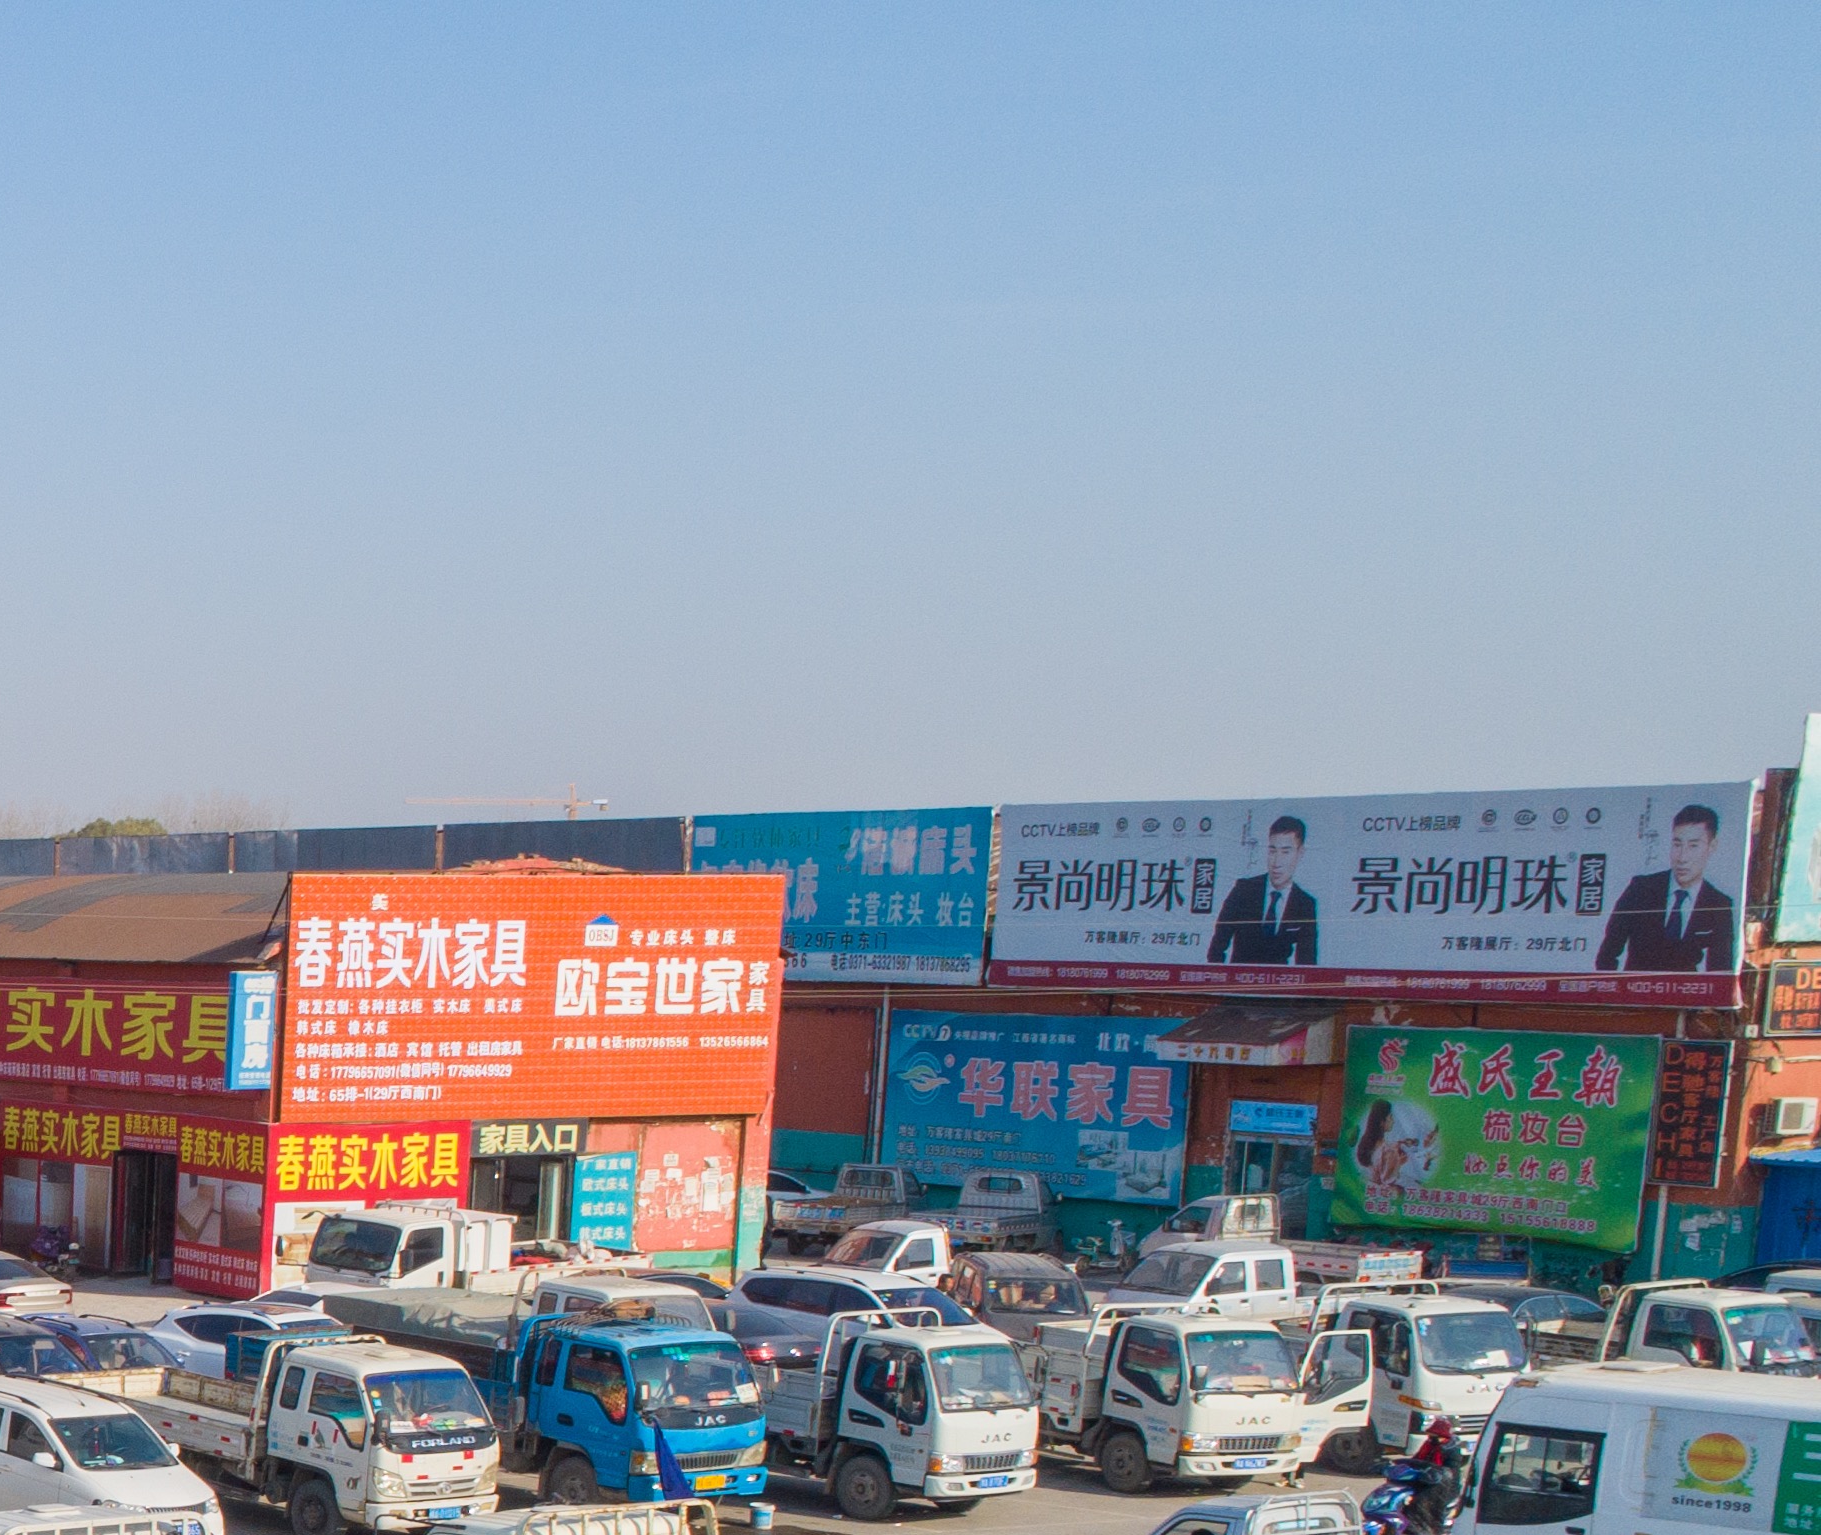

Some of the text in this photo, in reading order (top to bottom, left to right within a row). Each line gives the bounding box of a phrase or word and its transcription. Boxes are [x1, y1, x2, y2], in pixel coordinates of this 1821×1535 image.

[1012, 858, 1186, 913] 景尚明珠
[1193, 860, 1216, 912] 家居
[1351, 853, 1568, 915] 景尚明珠
[1577, 856, 1607, 914] 家居
[629, 928, 695, 946] 专业床头
[704, 928, 737, 946] 整床
[294, 916, 527, 990] 春燕实木家具
[554, 956, 771, 1017] 欧宝世家 家具
[433, 998, 471, 1014] 实木床
[296, 1020, 337, 1036] 韩式床
[466, 1040, 524, 1056] 出租房家具
[552, 1036, 597, 1050] 厂家直销
[1428, 1041, 1624, 1108] 盛氏王朝
[958, 1057, 1173, 1130] 华联家具
[3, 1106, 121, 1160] 春燕实木家具
[124, 1113, 178, 1138] 春燕实木家具
[1482, 1109, 1588, 1149] 梳妆台
[180, 1125, 265, 1176] 春燕实木家具
[478, 1124, 579, 1155] 家具入口
[275, 1132, 460, 1192] 春燕实木家具
[582, 1157, 633, 1172] 厂家直销
[581, 1176, 630, 1193] 欧式床头
[580, 1201, 628, 1218] 板式床头
[694, 1414, 727, 1427] JAC
[1235, 1415, 1273, 1426] JAC
[411, 1435, 476, 1449] FORLAND
[980, 1434, 1013, 1445] JAC
[1670, 1494, 1753, 1515] since1998
